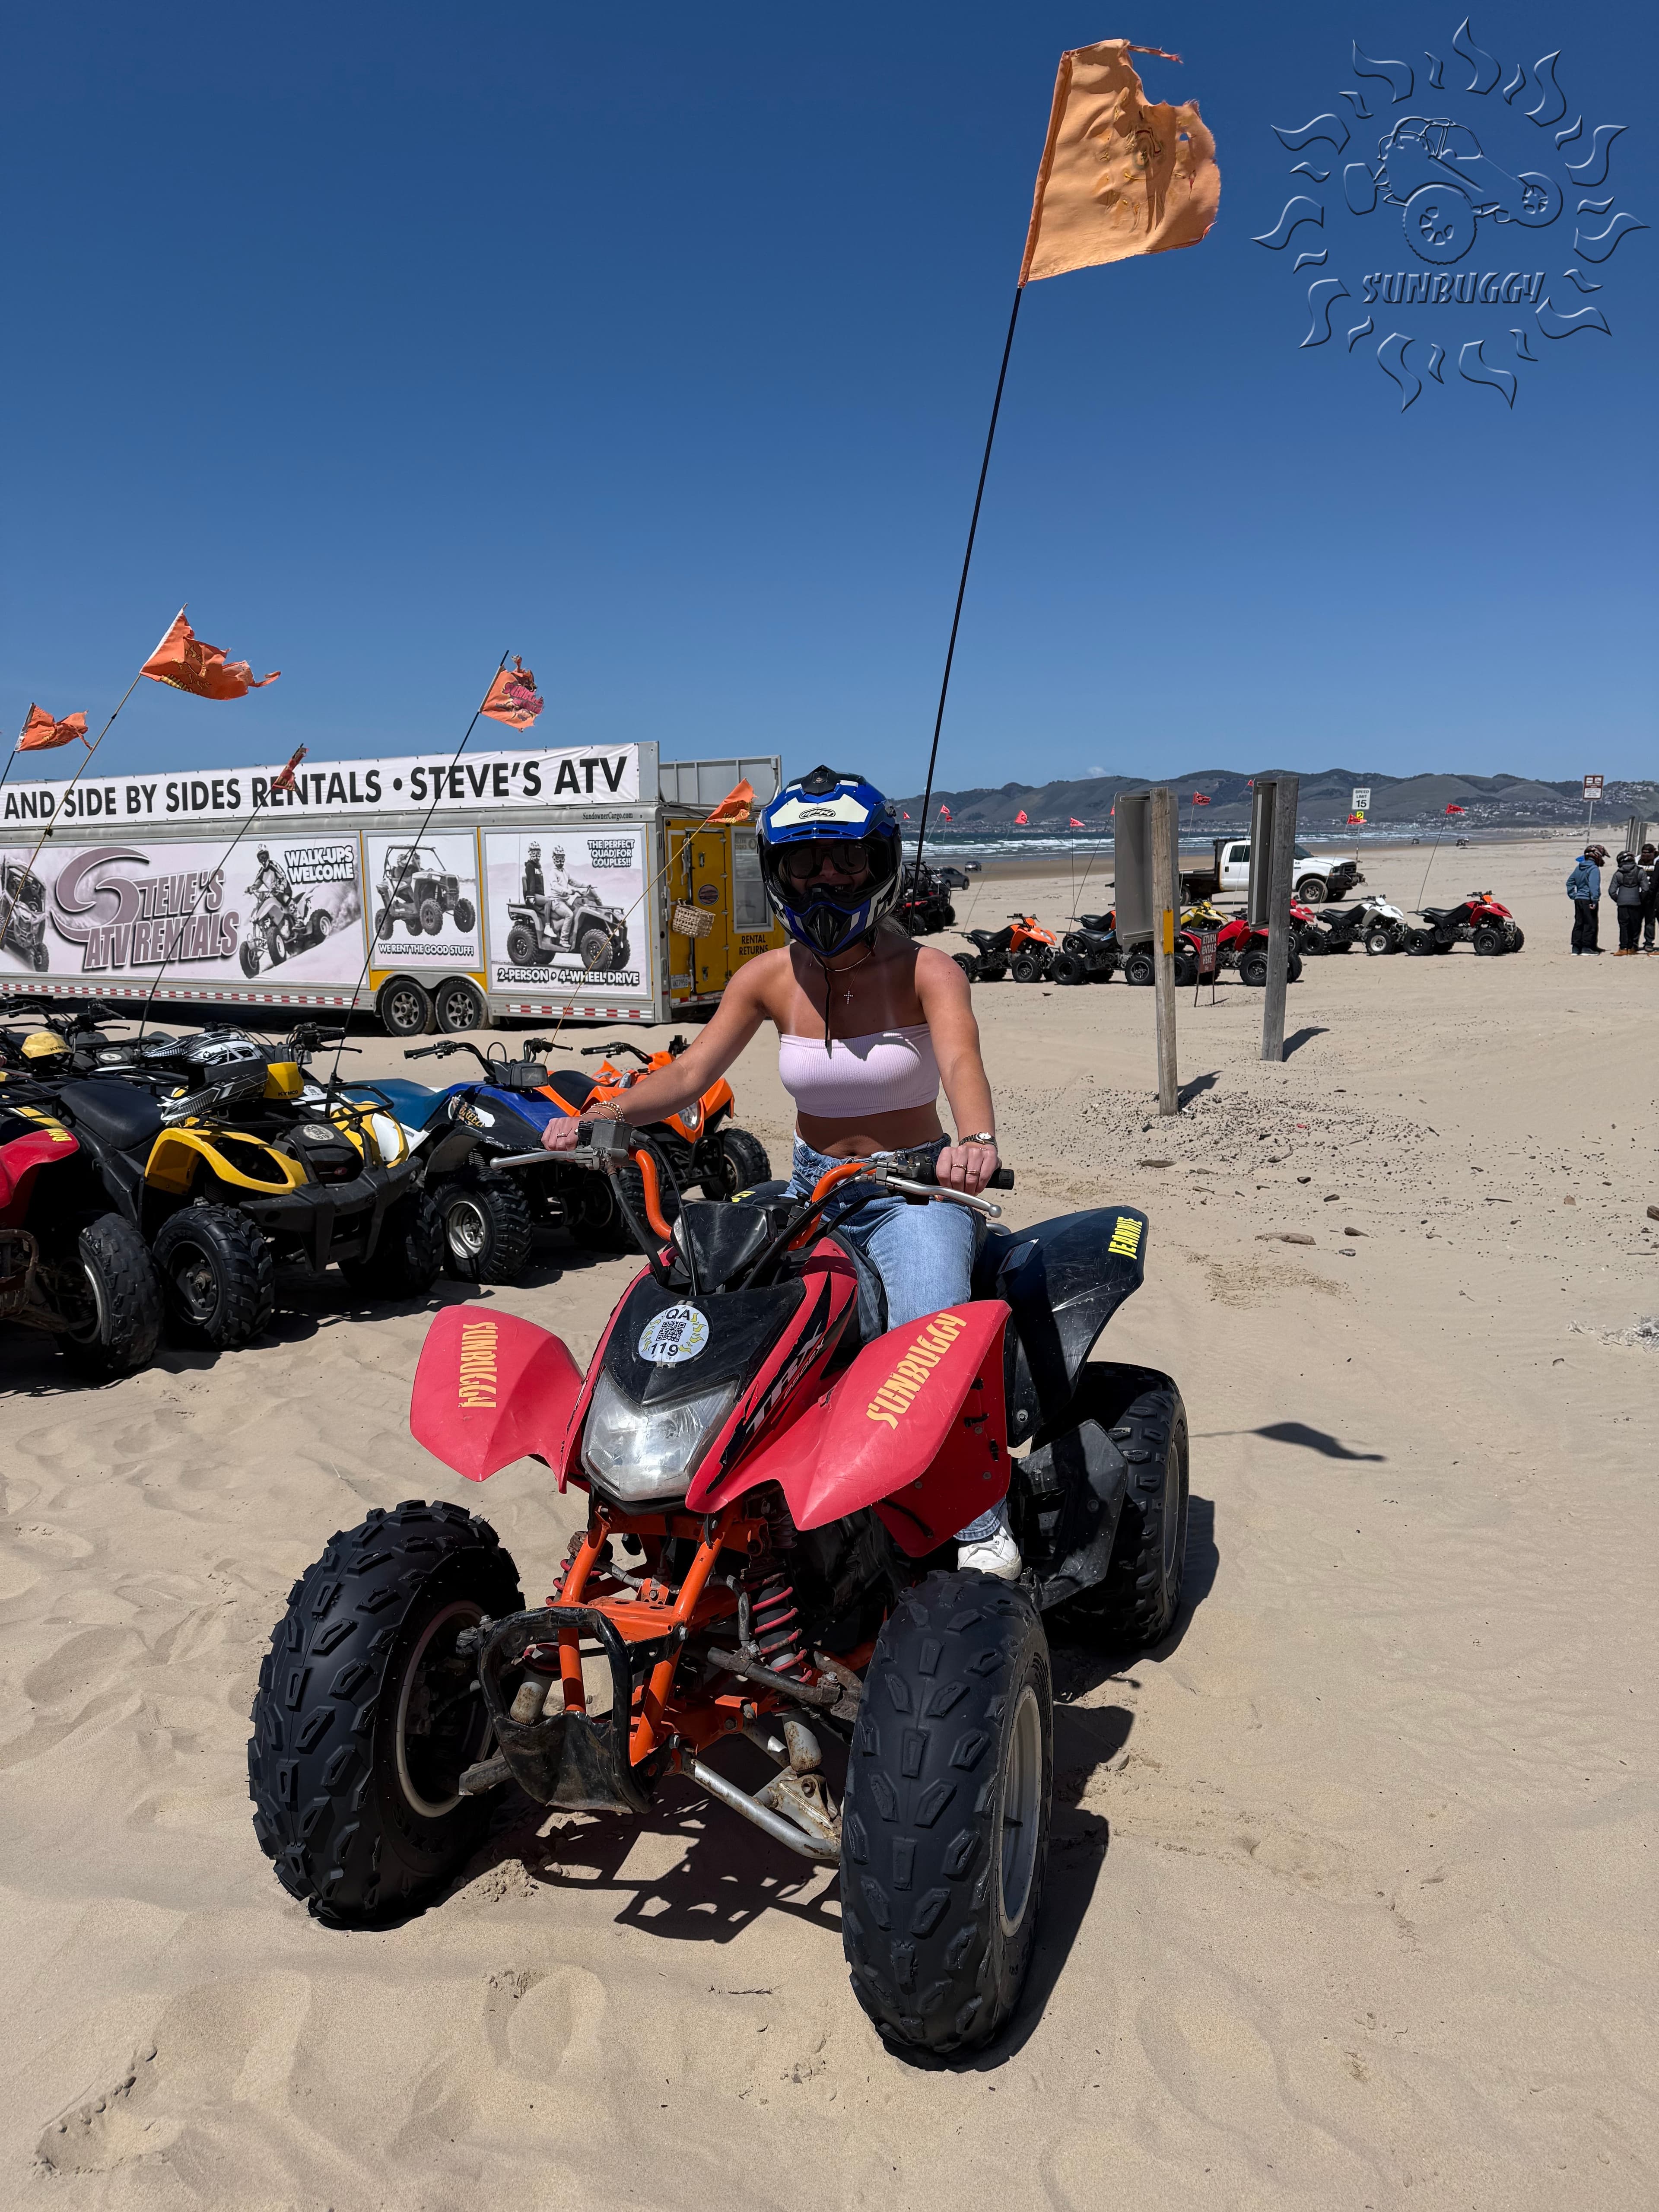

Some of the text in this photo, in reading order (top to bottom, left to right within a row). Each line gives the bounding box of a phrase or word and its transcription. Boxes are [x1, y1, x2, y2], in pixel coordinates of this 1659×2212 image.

[4, 756, 627, 819] AND SIDE BY SIDES RENTALS STEVE'S ATV
[583, 812, 633, 821] SundownerCargo.com
[588, 839, 635, 849] THE PERFECT
[285, 845, 354, 867] WALK-UPS
[591, 849, 632, 858] QUAD FOR
[592, 858, 631, 868] COUPLES!!
[288, 863, 354, 884] WELCOME
[84, 910, 240, 969] ATV RENTALS
[742, 934, 766, 944] RENTAL
[378, 944, 474, 956] WE RENT THE GOOD STUFF!
[739, 945, 768, 956] RETURNS
[1203, 954, 1212, 965] HERE
[498, 968, 640, 985] 2-PERSON 4-WHEEL DRIVE
[1108, 1216, 1142, 1260] JEANNIE
[666, 1309, 690, 1321] QA
[651, 1342, 679, 1356] 119
[458, 1322, 499, 1408] SUNBUGGY
[866, 1313, 967, 1430] SUNBUGGY
[746, 1320, 823, 1433] TRX
